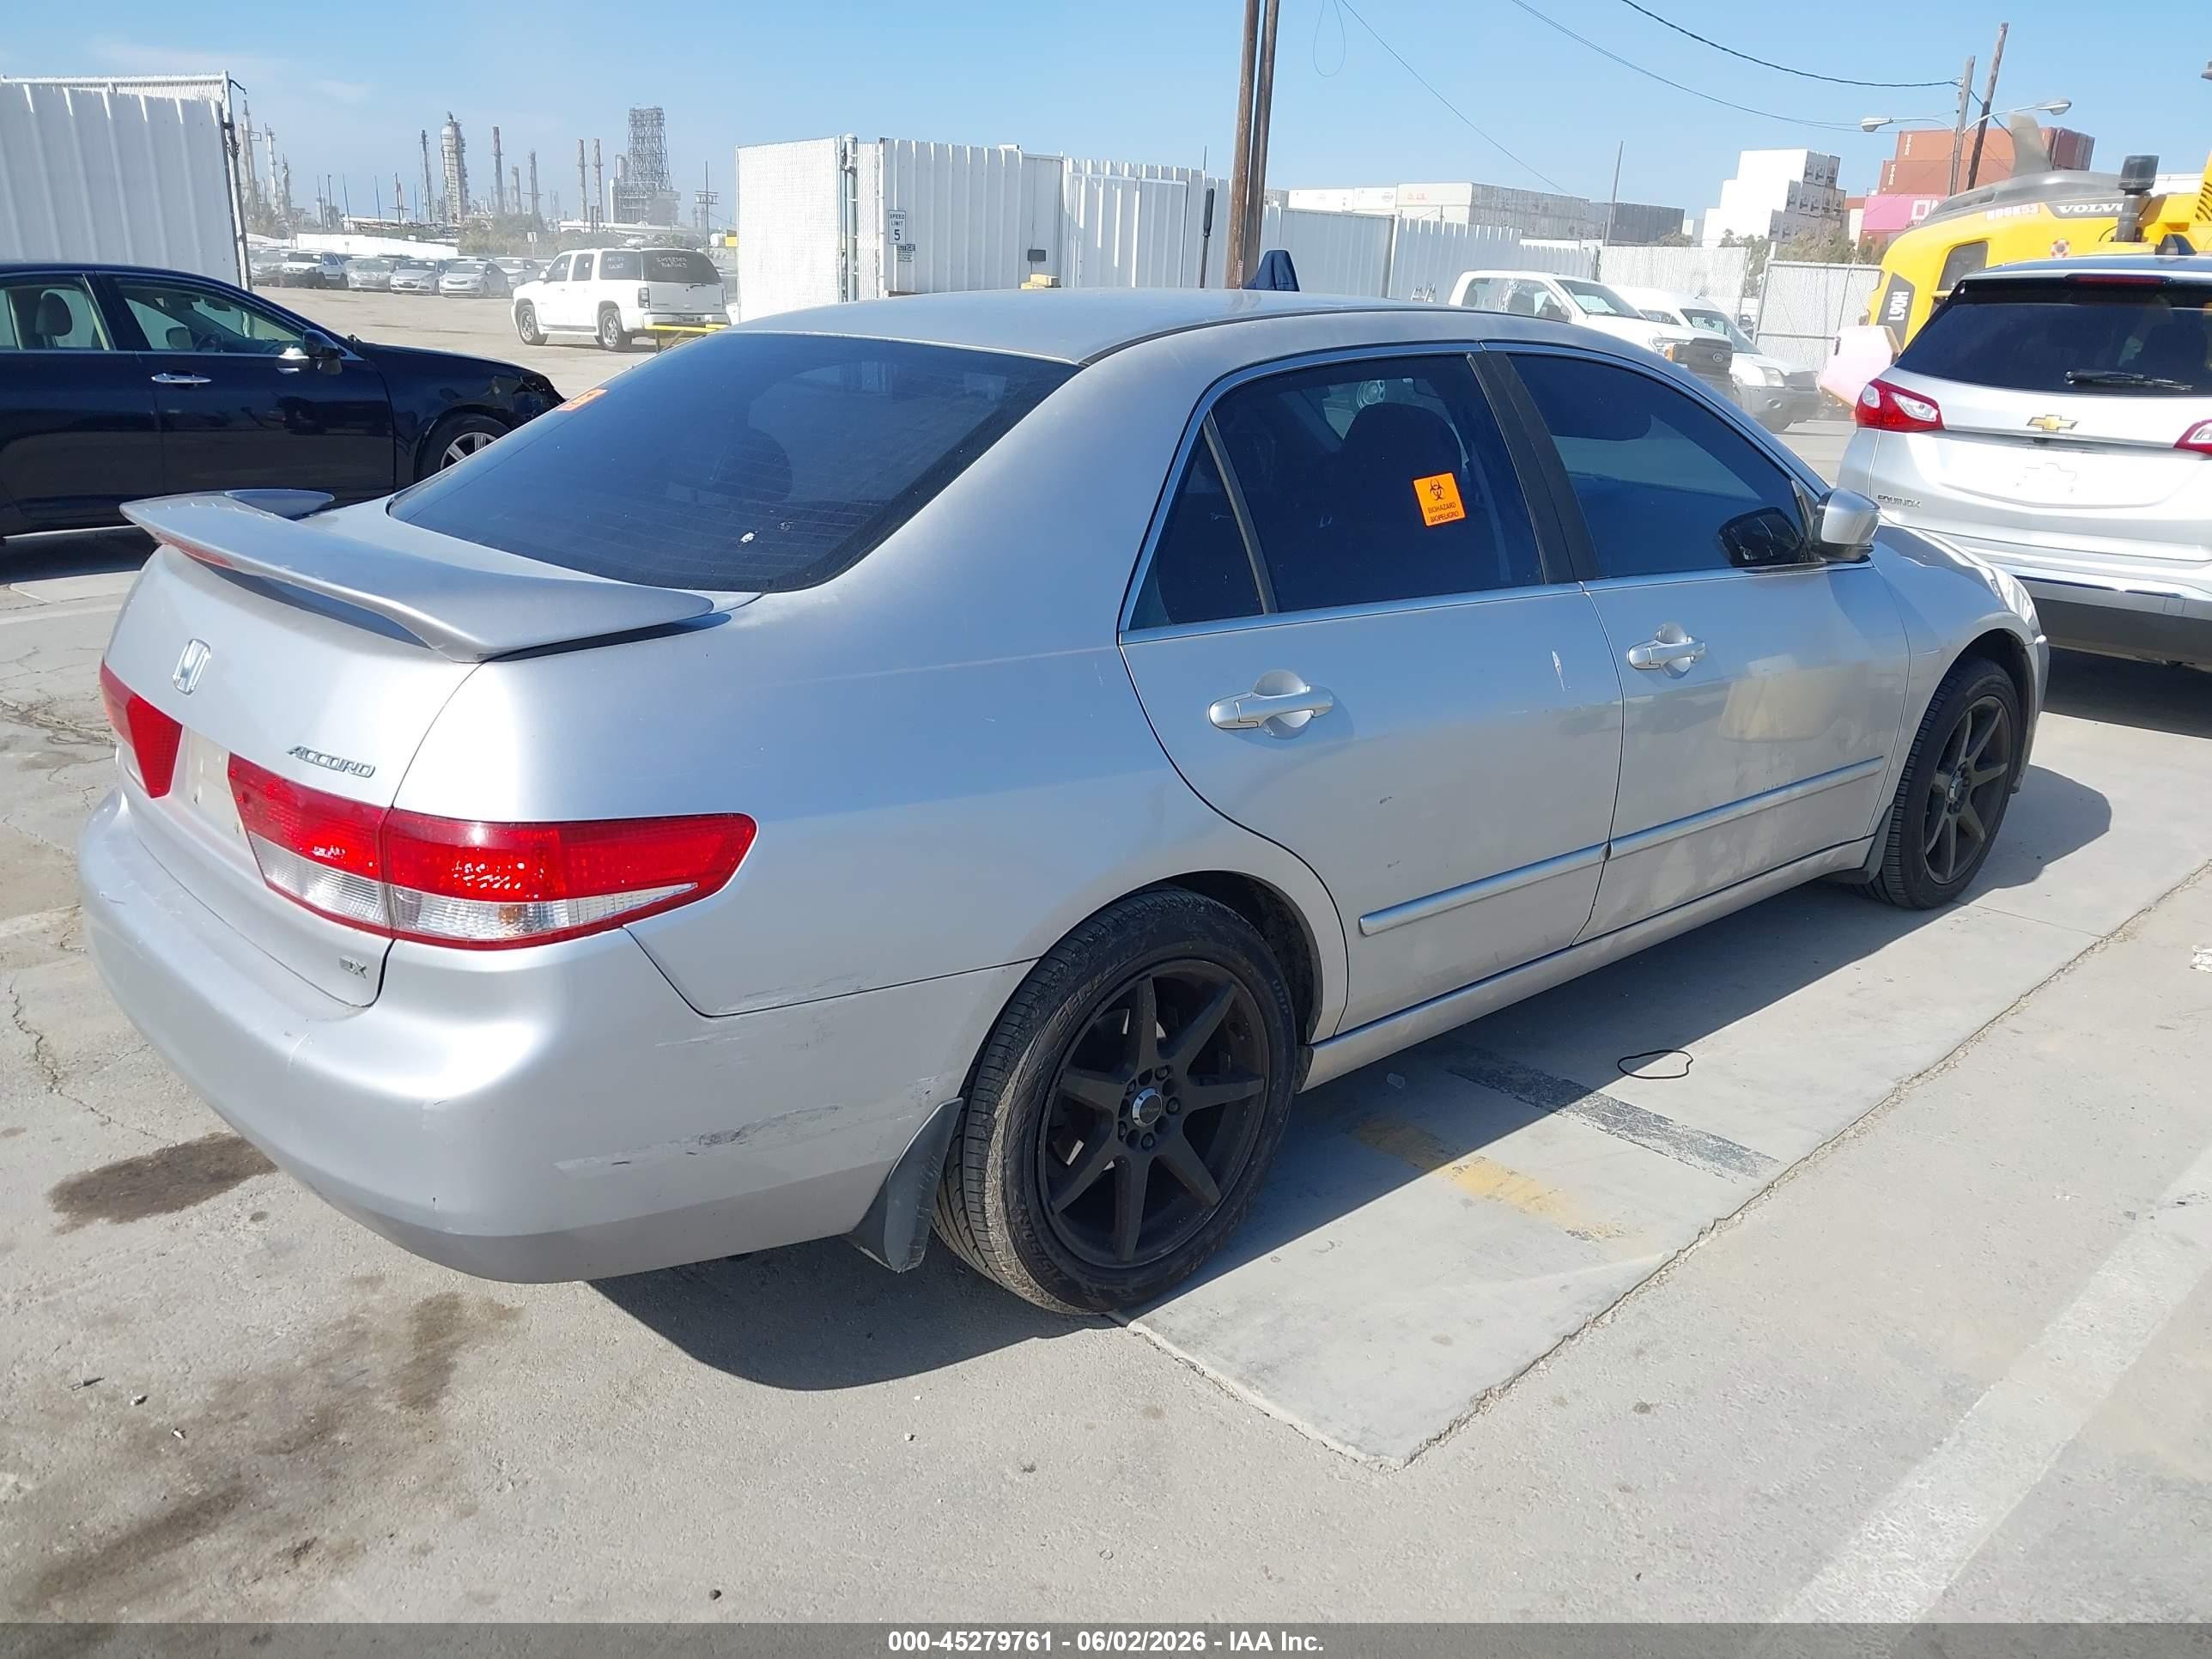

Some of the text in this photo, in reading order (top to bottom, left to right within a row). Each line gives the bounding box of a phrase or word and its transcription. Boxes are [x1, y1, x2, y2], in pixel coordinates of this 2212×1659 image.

[894, 228, 901, 240] 5
[1427, 501, 1457, 514] BIOHAZARD
[286, 745, 376, 778] ACCORD
[338, 956, 368, 980] EX
